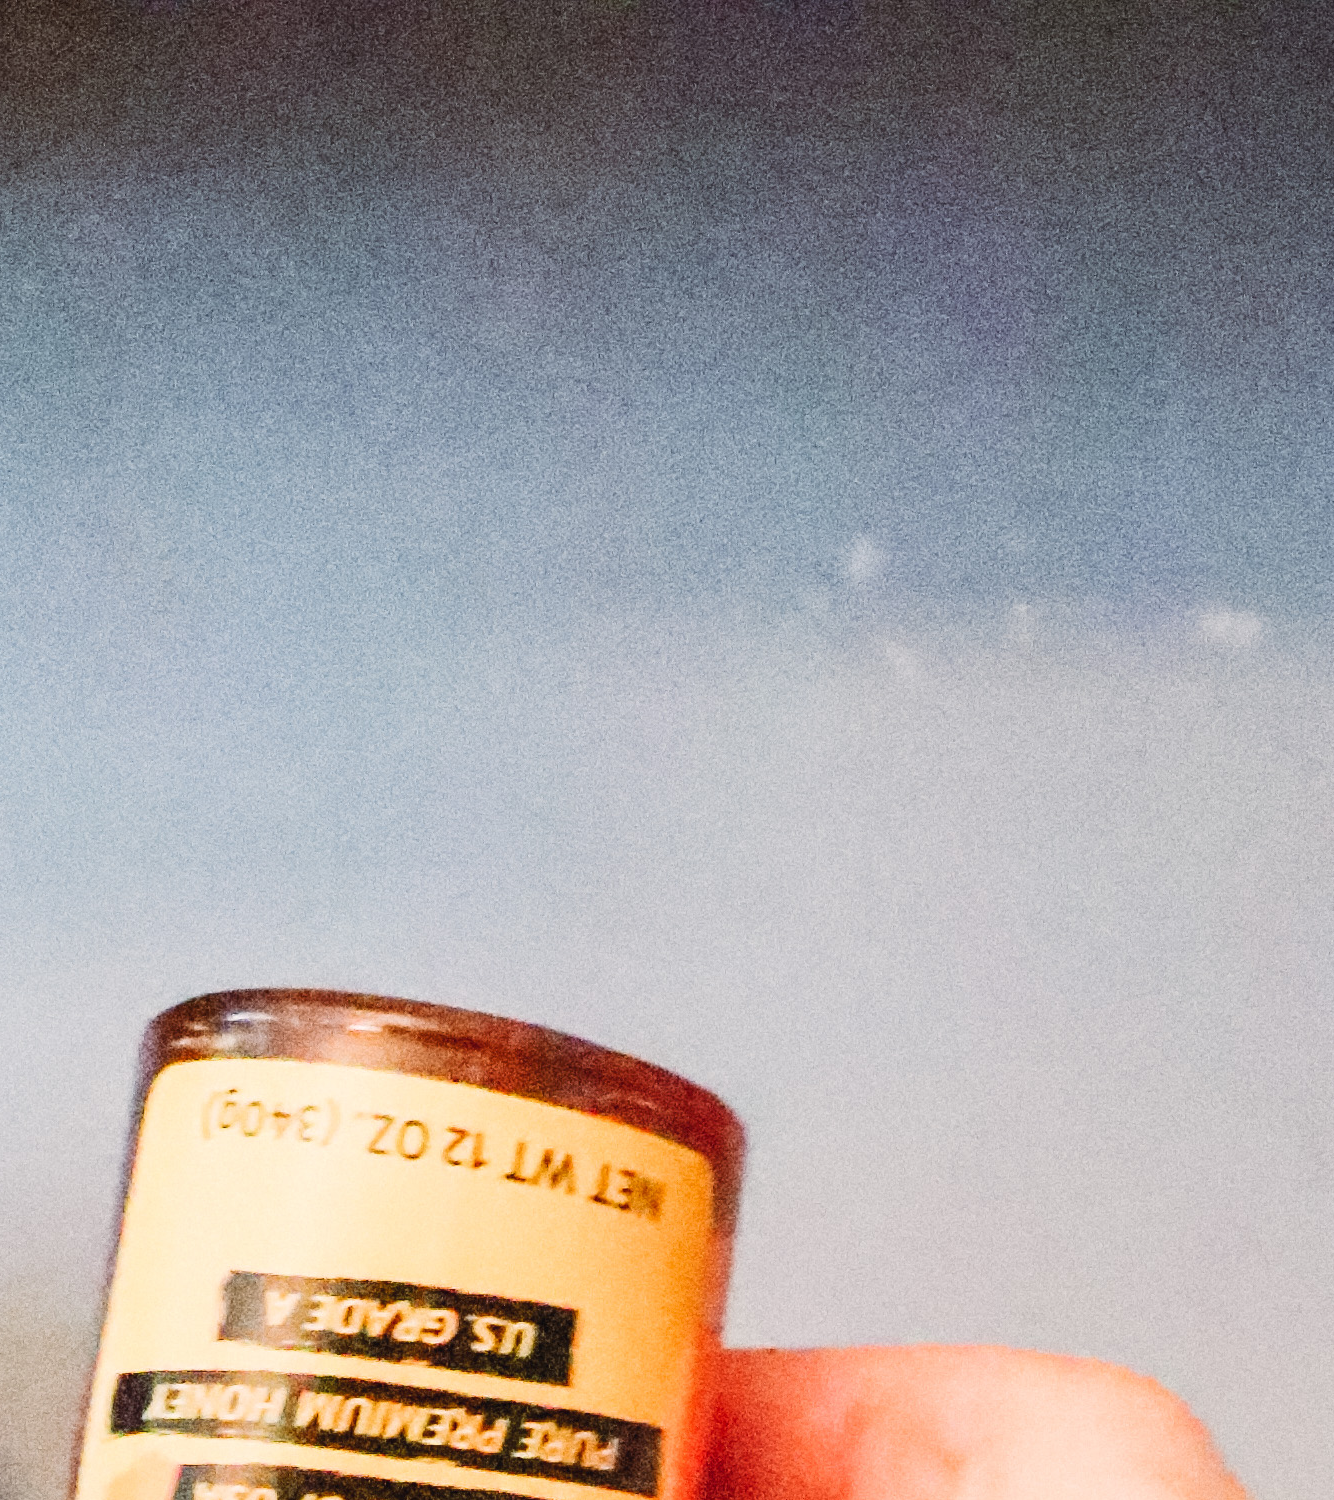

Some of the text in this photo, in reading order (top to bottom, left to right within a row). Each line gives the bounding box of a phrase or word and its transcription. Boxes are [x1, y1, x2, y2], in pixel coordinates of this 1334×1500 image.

[200, 1088, 664, 1221] NET WT 12 OZ. (340g)
[264, 1289, 300, 1325] A
[301, 1294, 457, 1344] GRADE
[140, 1382, 618, 1469] PURE PREMIUM HONEY
